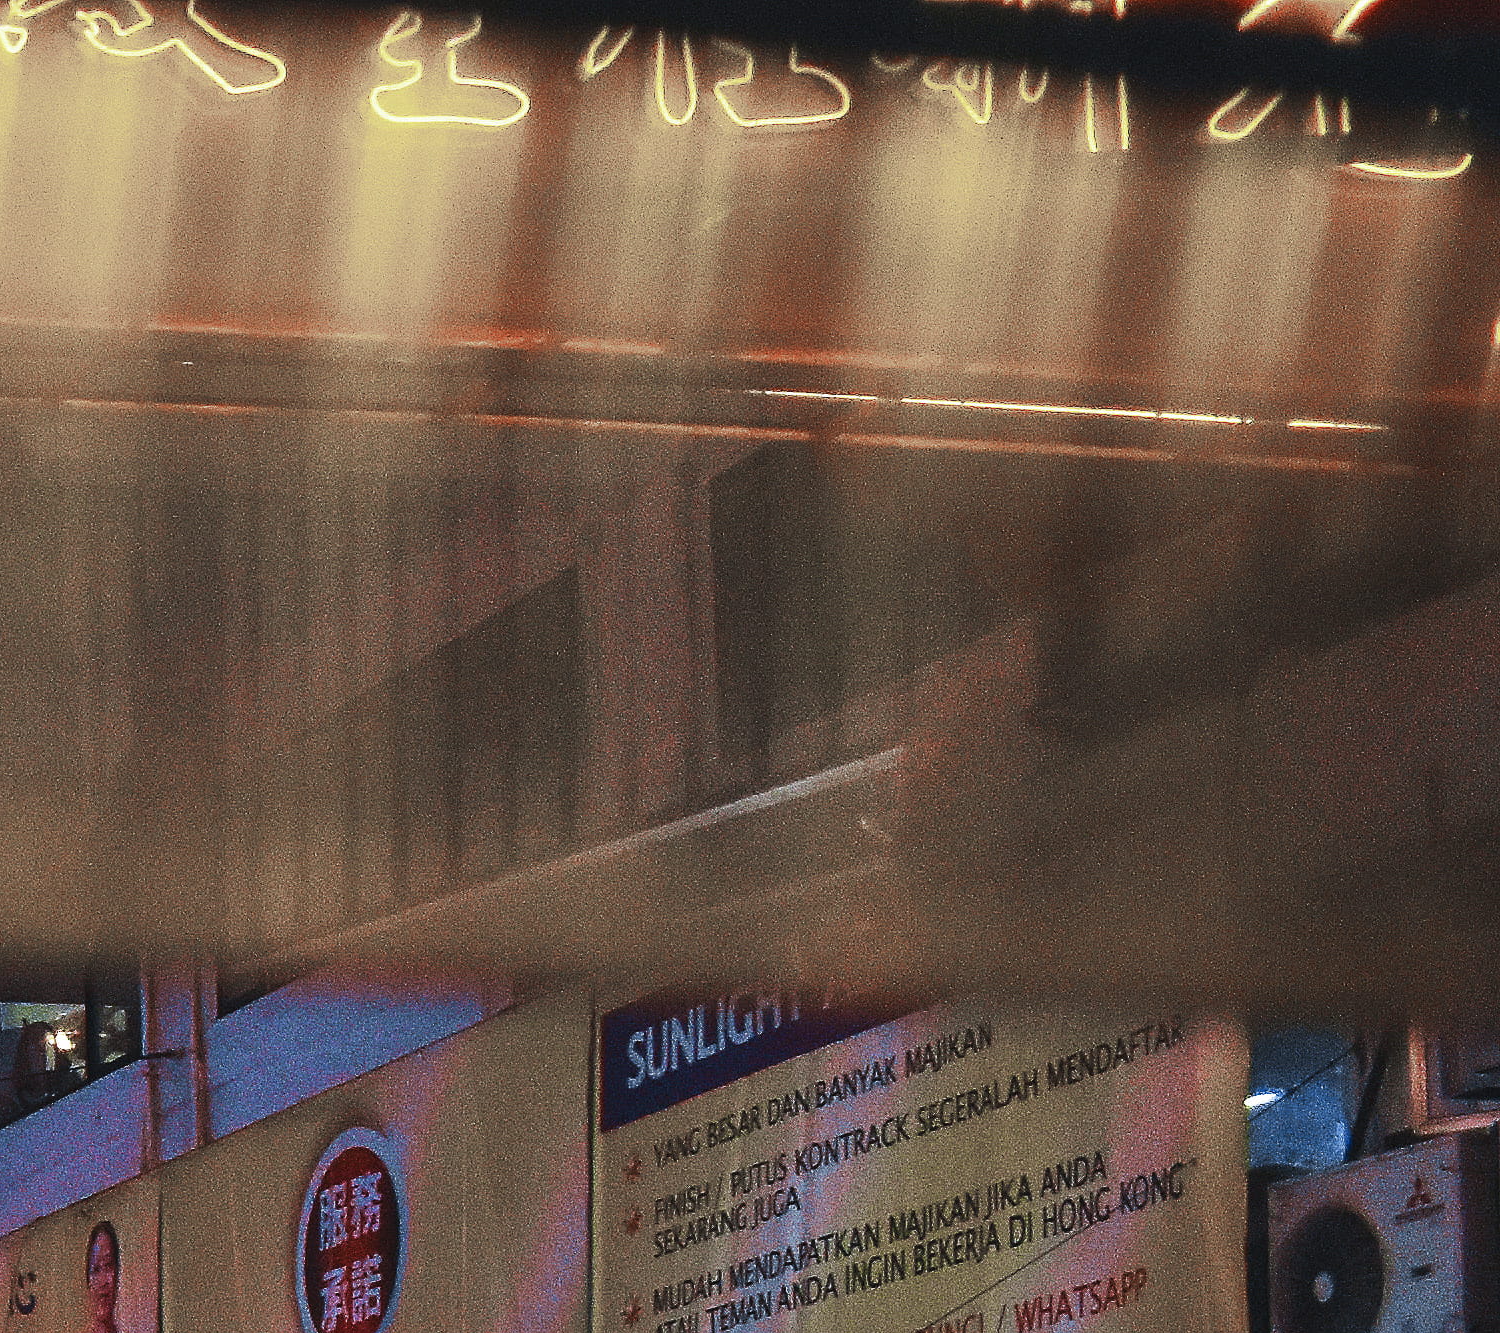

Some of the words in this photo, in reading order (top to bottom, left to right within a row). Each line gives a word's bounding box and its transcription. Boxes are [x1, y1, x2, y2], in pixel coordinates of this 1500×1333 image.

[707, 1106, 762, 1148] BESAR
[768, 1088, 810, 1126] DAN
[815, 1056, 896, 1109] BANYAK
[905, 1023, 991, 1077] MAJIKAN
[730, 1153, 787, 1197] PUTUS
[794, 1113, 911, 1176] KONTRACK
[917, 1067, 1040, 1136] SEGERALAH
[1047, 1020, 1185, 1090] MENDAFTAR
[319, 1169, 384, 1251] 服務
[652, 1270, 724, 1316] MUDAH
[730, 1222, 880, 1297] MENDAPATKAN
[888, 1190, 980, 1245] MAJIKAN
[986, 1174, 1033, 1215] JIKA
[1041, 1151, 1107, 1198] ANDA
[654, 1203, 747, 1258] SEKARANG
[751, 1186, 801, 1230] JUGA
[779, 1268, 839, 1313] ANDA
[846, 1249, 907, 1294] INGIN
[913, 1223, 1001, 1276] BEKERJA
[1007, 1214, 1035, 1250] DI
[1040, 1191, 1111, 1238] HONG
[1119, 1165, 1184, 1218] KONG
[320, 1254, 384, 1329] 承諾
